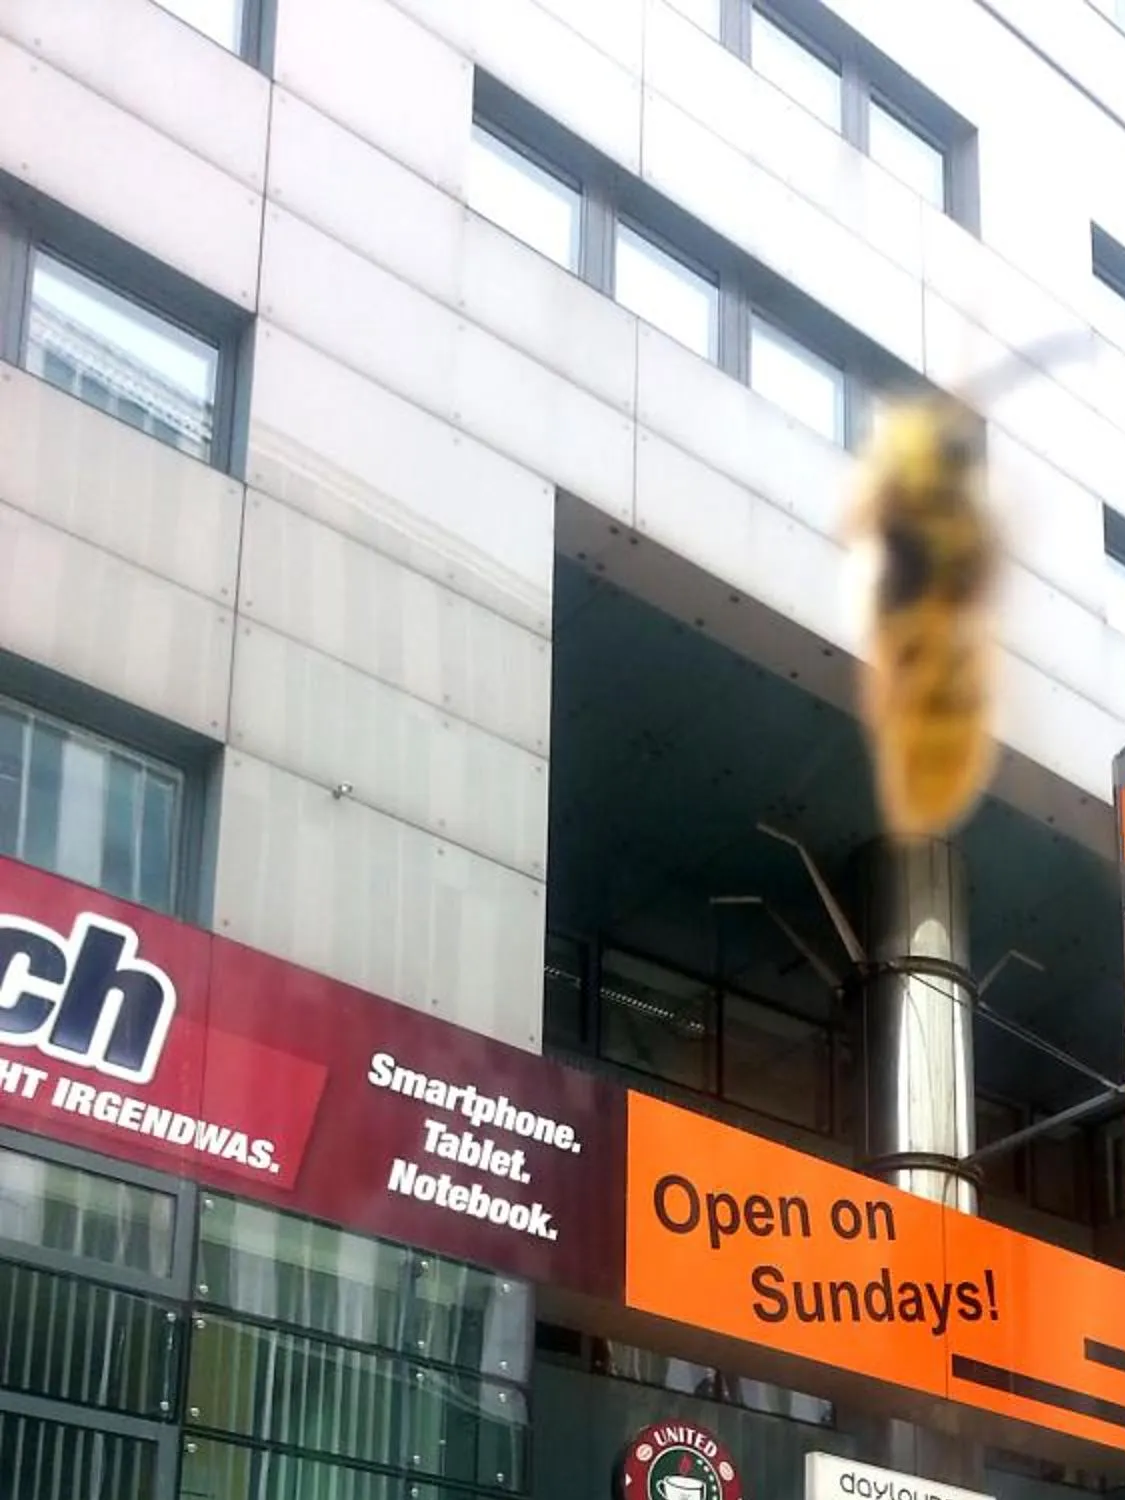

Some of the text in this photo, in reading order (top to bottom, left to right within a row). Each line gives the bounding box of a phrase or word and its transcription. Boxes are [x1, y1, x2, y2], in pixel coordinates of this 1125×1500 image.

[51, 1076, 280, 1173] IRGENDWAS.
[367, 1052, 582, 1154] Smartphone.
[424, 1118, 532, 1184] Tablet.
[387, 1158, 559, 1241] Notebook.
[652, 1174, 897, 1248] Open on
[751, 1264, 1001, 1337] Sundays!
[653, 1426, 717, 1458] UNITED
